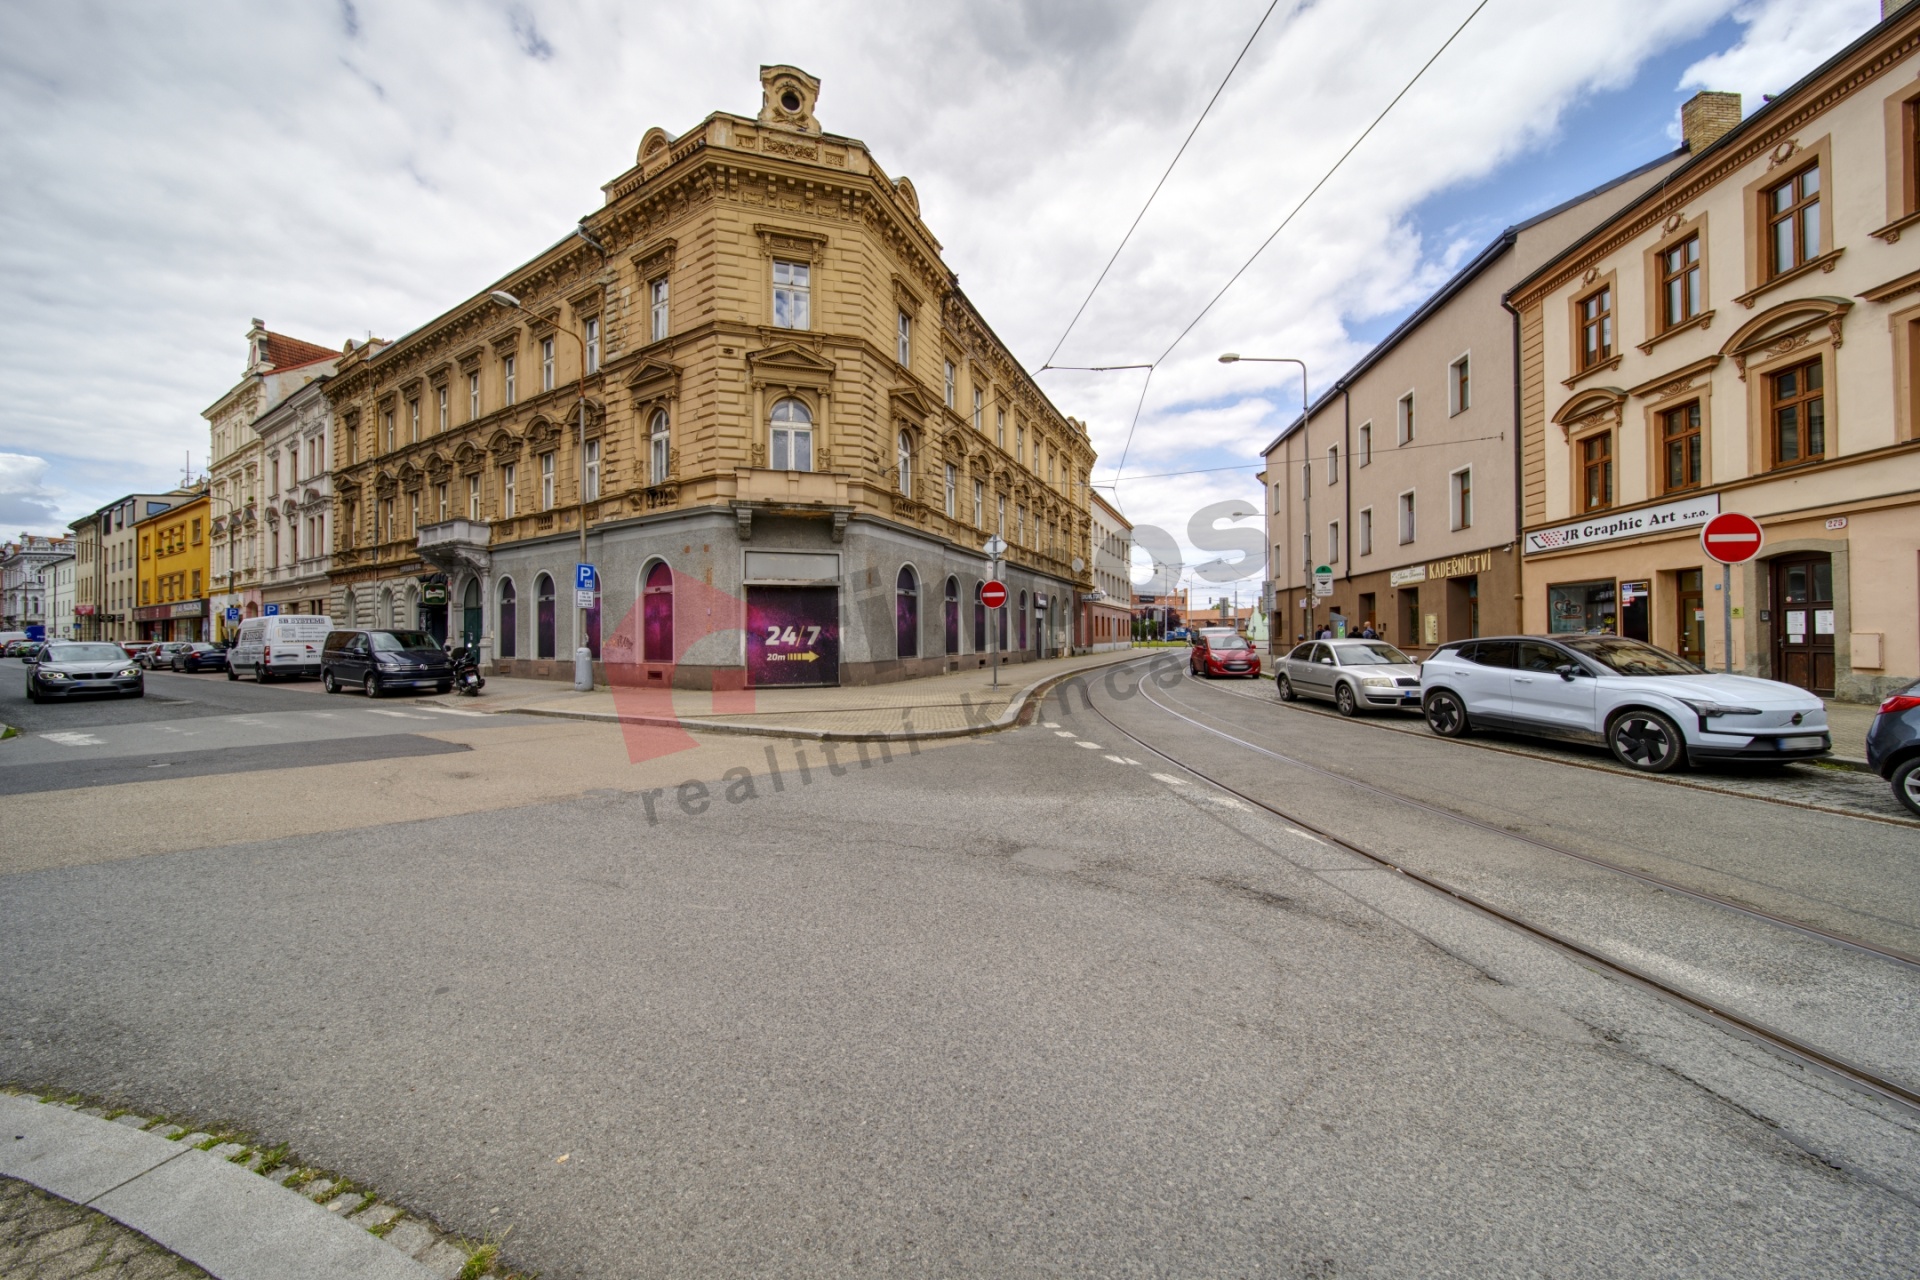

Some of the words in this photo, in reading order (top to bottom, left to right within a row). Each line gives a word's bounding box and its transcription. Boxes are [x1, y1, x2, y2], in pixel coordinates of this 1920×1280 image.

[1562, 528, 1579, 542] JR
[1583, 517, 1642, 538] Graphic
[1649, 511, 1676, 526] Art
[1683, 509, 1709, 520] s.r.o.
[1827, 520, 1844, 528] 275
[580, 566, 591, 582] P
[229, 608, 237, 618] P
[267, 605, 276, 615] P
[764, 625, 822, 647] 24/7
[766, 653, 786, 661] 20m
